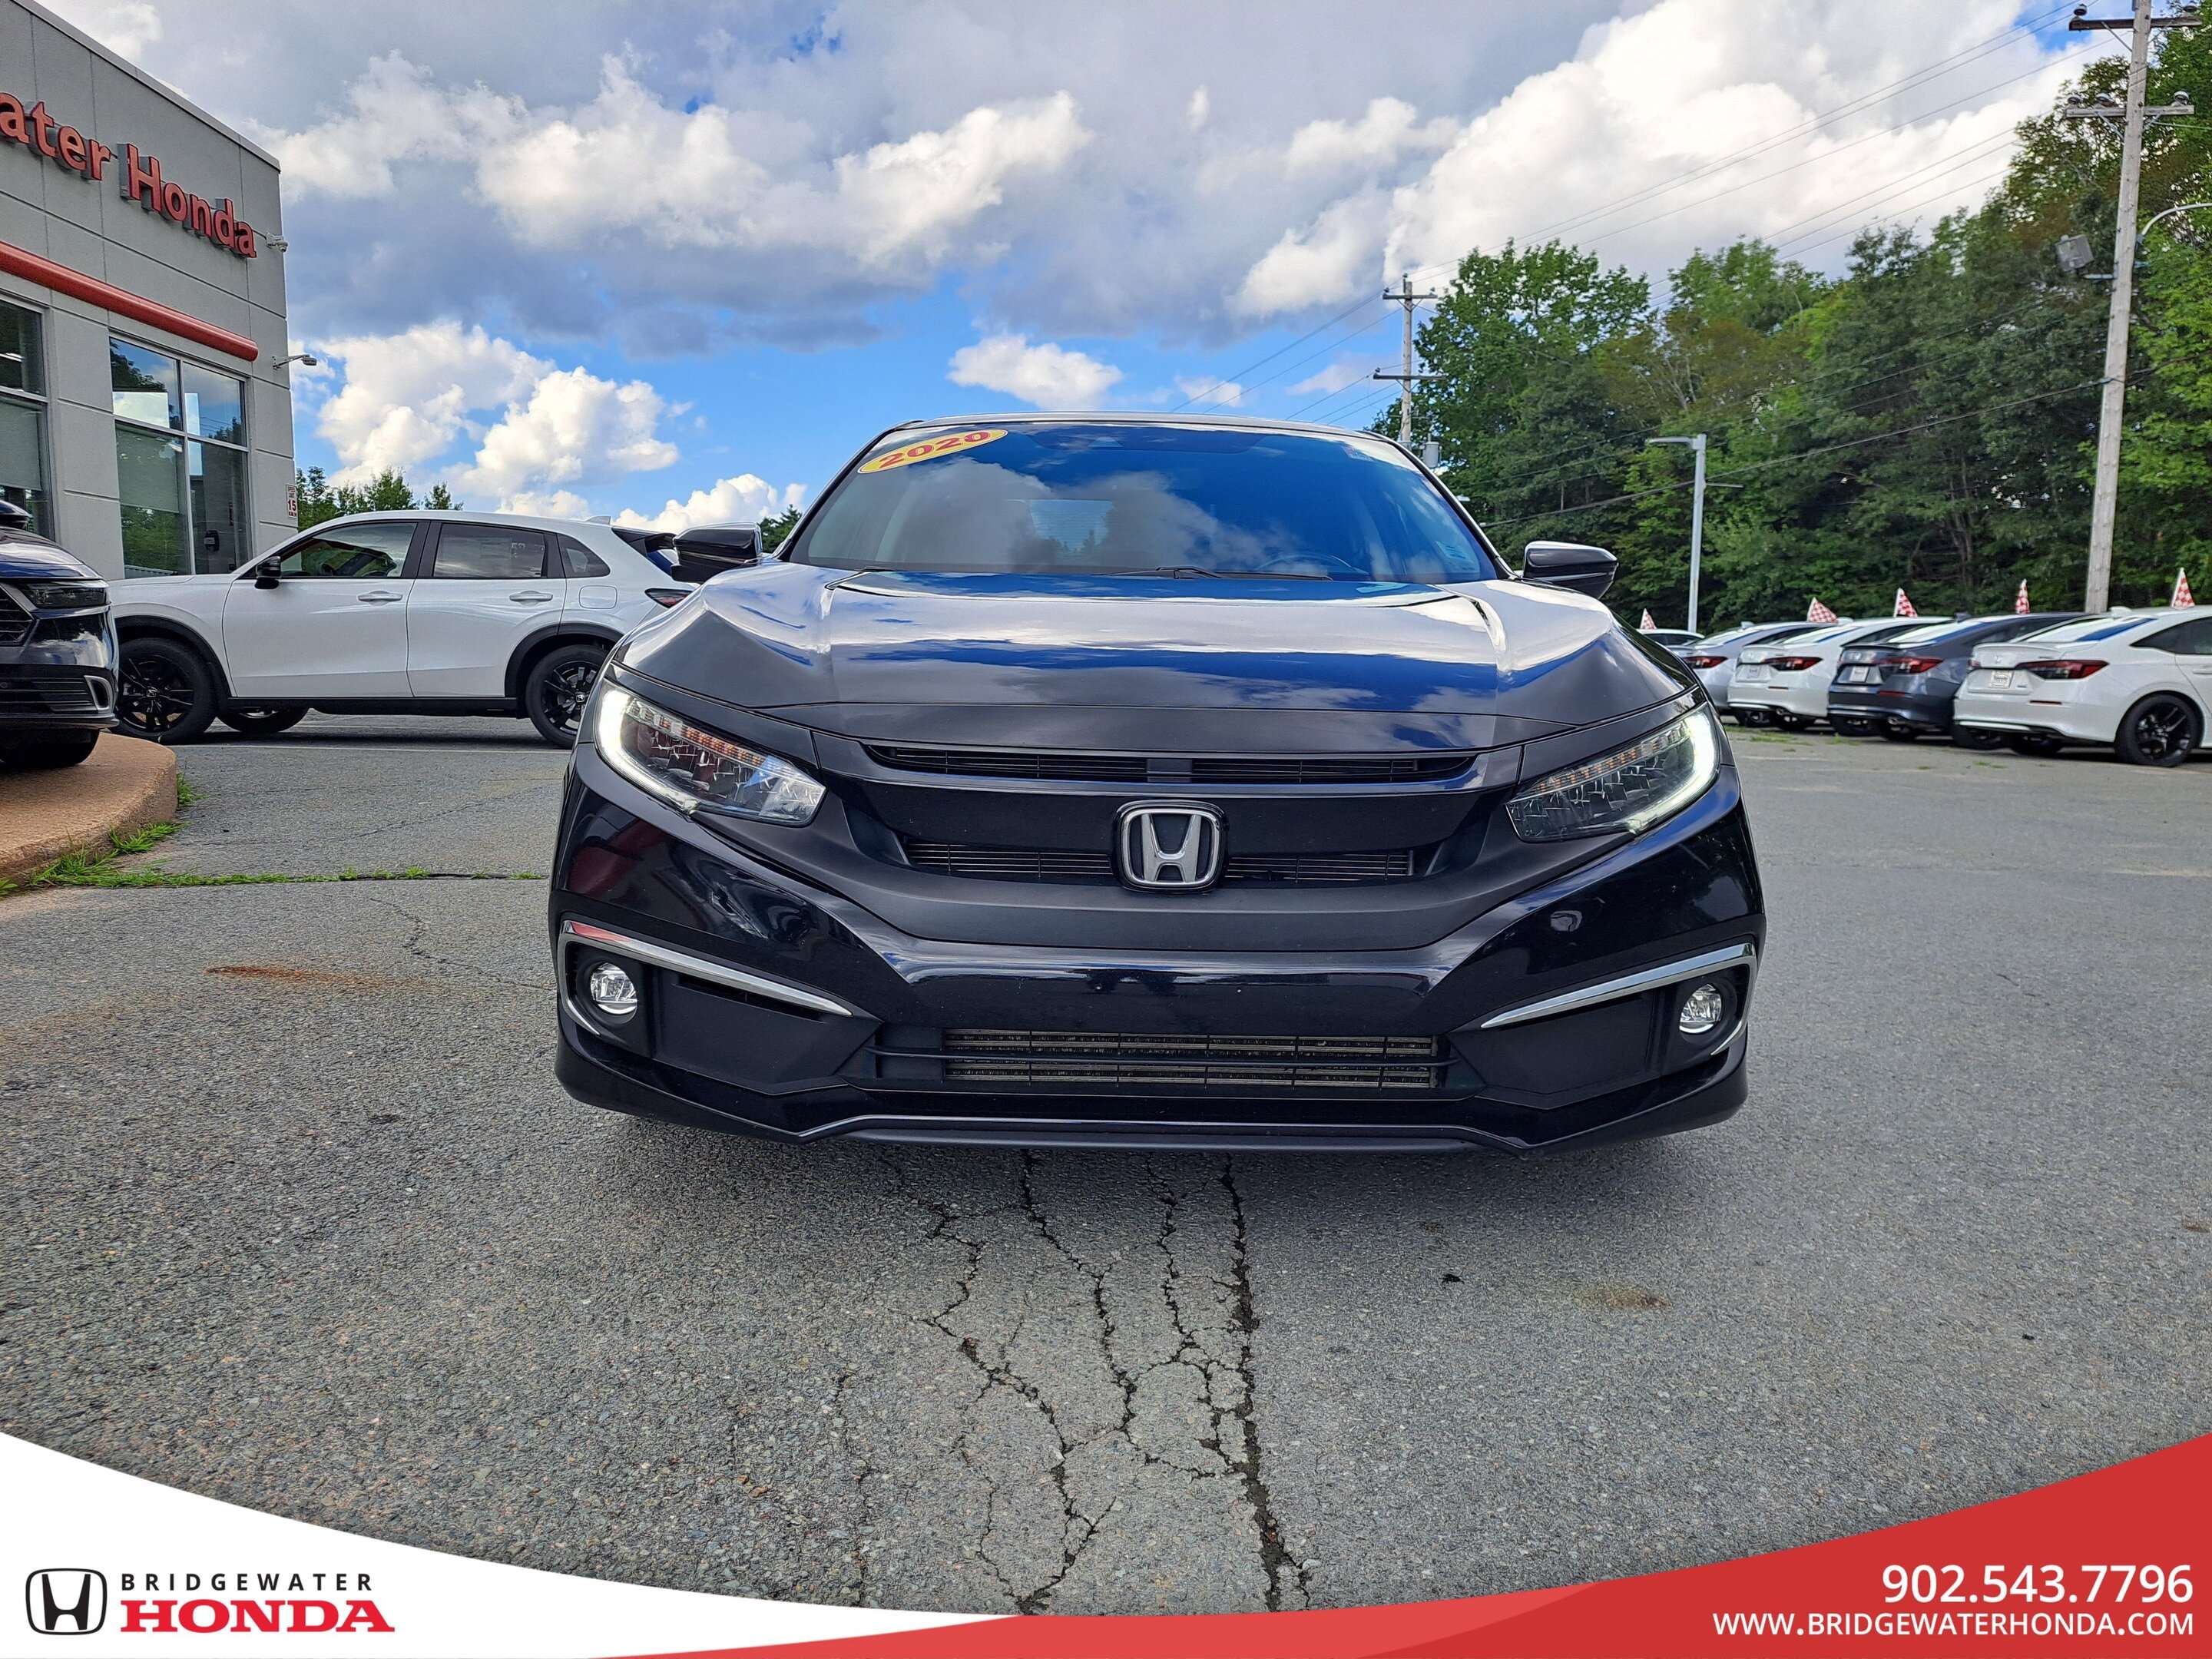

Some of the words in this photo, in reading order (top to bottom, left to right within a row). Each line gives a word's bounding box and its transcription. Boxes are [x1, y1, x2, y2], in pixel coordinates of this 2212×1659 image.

[124, 143, 257, 258] Honda
[878, 431, 992, 469] 2020
[287, 499, 296, 512] 15
